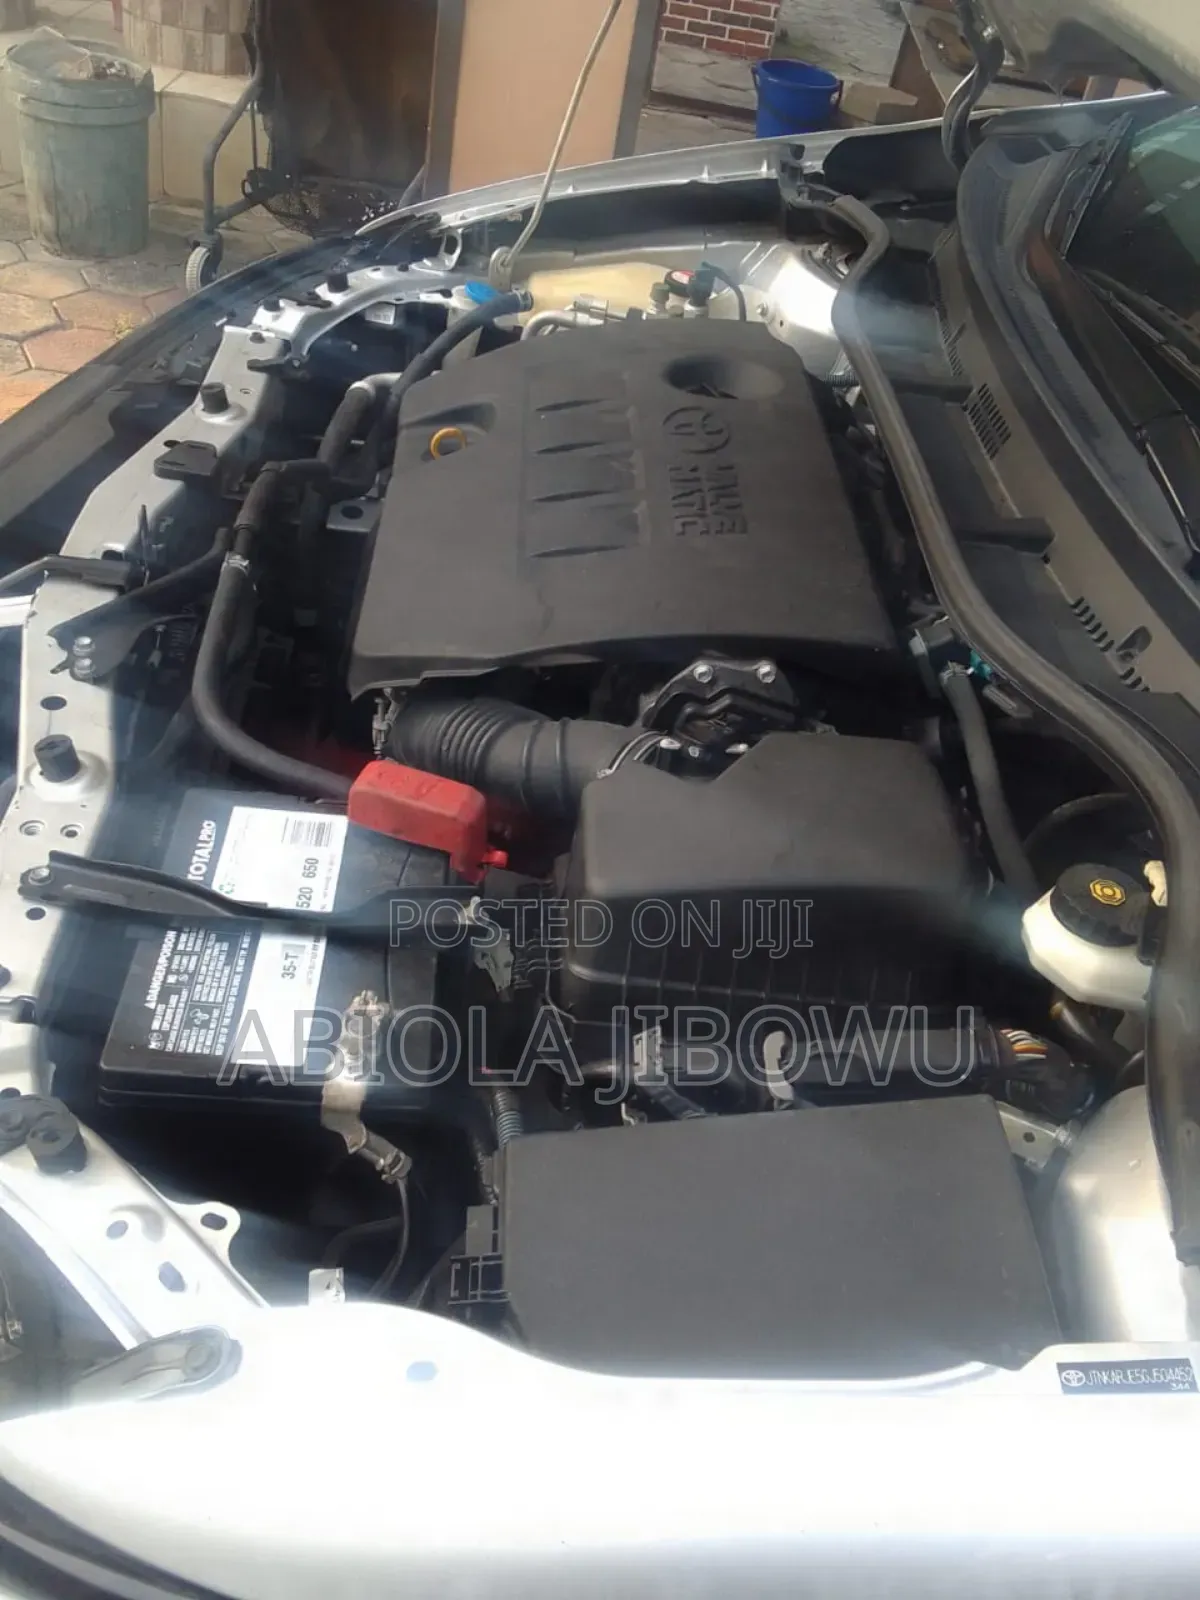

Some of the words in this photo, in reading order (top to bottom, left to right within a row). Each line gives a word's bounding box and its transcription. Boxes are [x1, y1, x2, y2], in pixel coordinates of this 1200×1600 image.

[302, 857, 319, 879] 650
[296, 886, 313, 909] 520
[281, 952, 299, 980] 35-T
